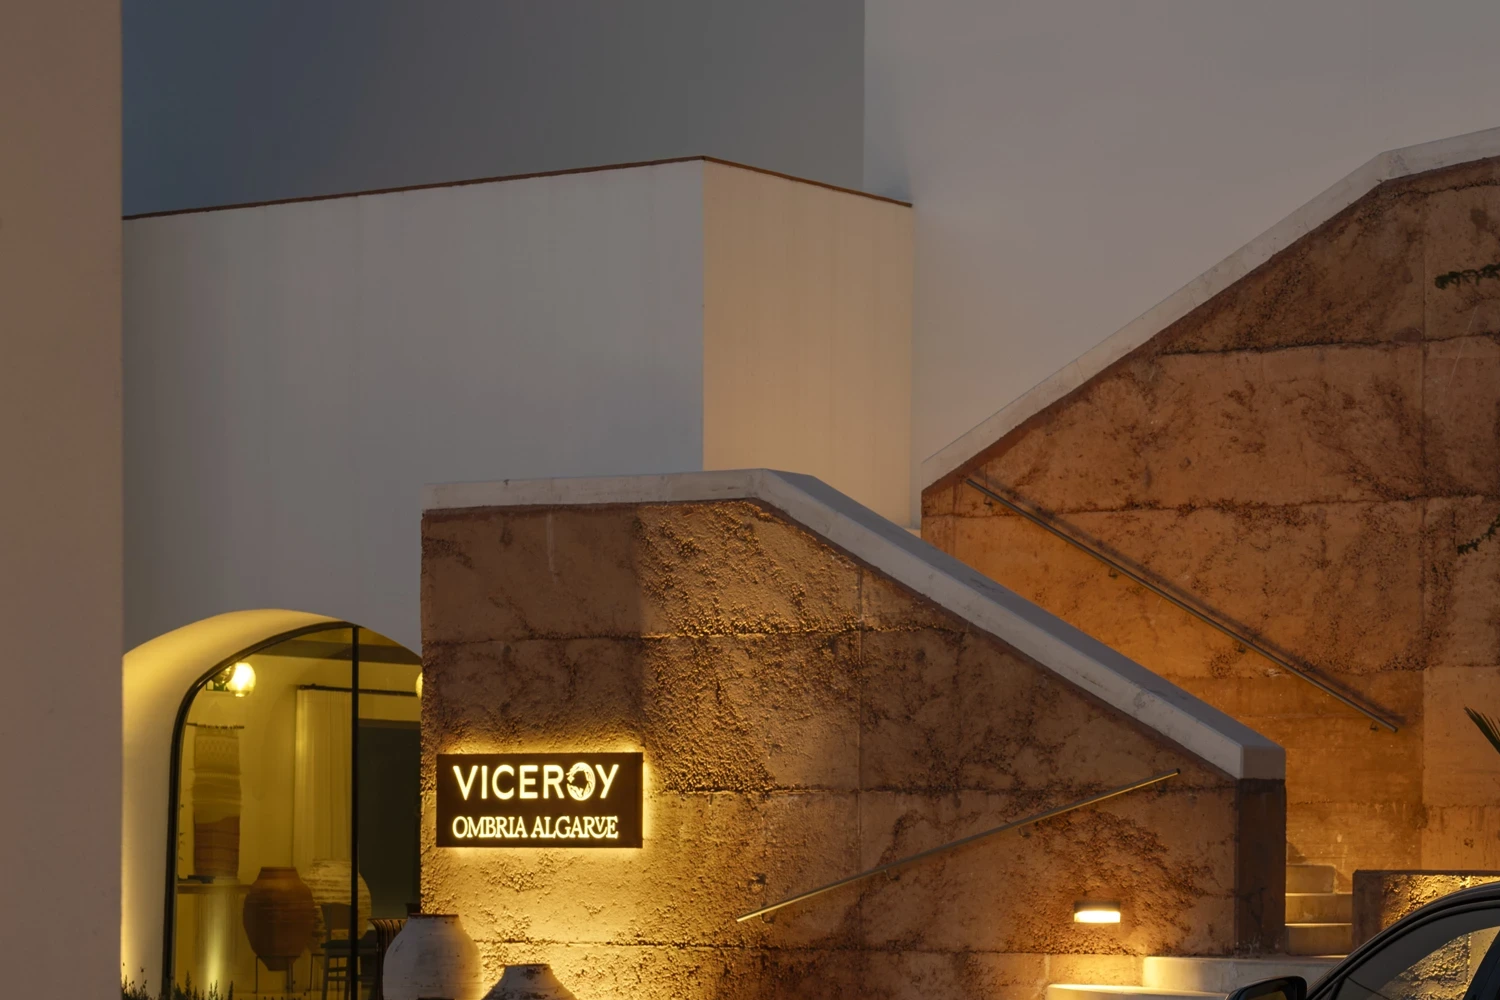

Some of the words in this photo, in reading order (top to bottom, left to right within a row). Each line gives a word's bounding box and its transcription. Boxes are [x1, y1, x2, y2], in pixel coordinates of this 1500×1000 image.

[452, 762, 619, 801] VICEROY
[452, 815, 528, 839] OMBRIA
[530, 815, 619, 839] ALGARVE
